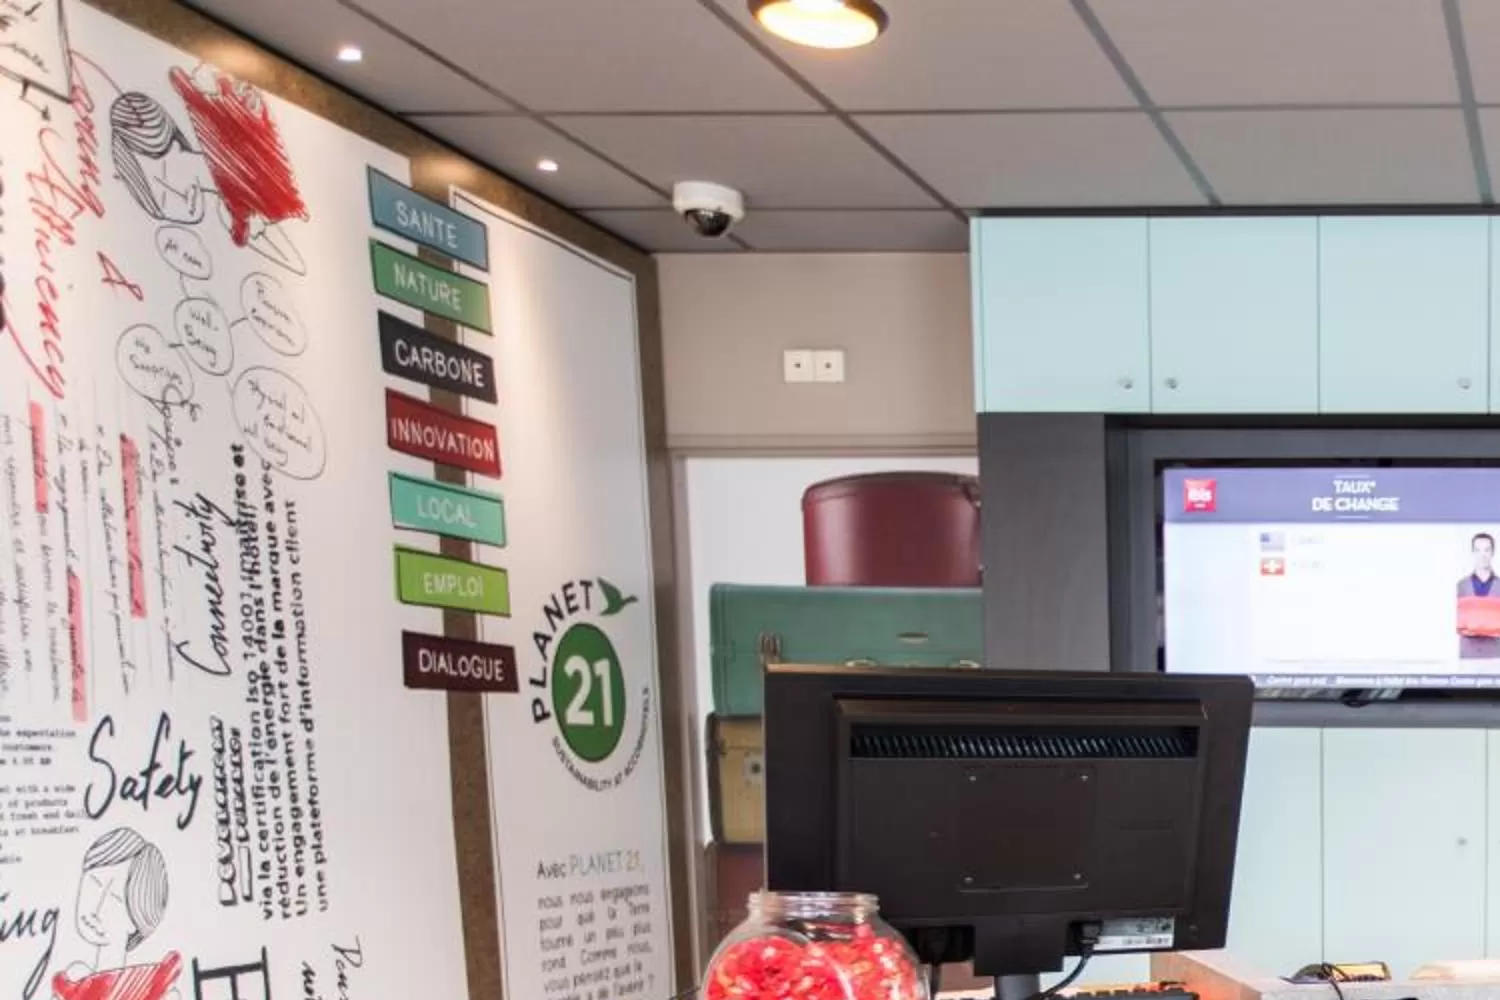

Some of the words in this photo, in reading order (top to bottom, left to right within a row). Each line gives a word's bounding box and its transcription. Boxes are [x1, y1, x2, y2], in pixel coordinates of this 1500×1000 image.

[394, 262, 462, 311] NATURE
[395, 339, 485, 387] CARBONE
[230, 443, 243, 468] et
[391, 417, 496, 463] INNOVATION
[261, 458, 275, 514] avec
[1311, 497, 1333, 511] DE
[1335, 497, 1399, 511] CHANGE
[283, 500, 301, 565] client
[416, 494, 478, 529] LOCAL
[173, 492, 236, 676] Connectivity
[263, 520, 283, 612] marque
[423, 572, 484, 598] EMPLOI
[252, 597, 267, 653] dans
[272, 619, 284, 639] la
[273, 646, 288, 674] de
[288, 572, 314, 732] d'information
[418, 648, 505, 681] DIALOGUE
[529, 580, 593, 724] PLANET
[277, 680, 291, 724] fort
[563, 654, 614, 727] 21
[84, 711, 203, 831] Safety
[251, 711, 270, 853] certification
[267, 770, 281, 799] de
[279, 731, 304, 878] engagement
[304, 738, 327, 865] plateforme
[257, 861, 271, 880] la
[273, 806, 292, 919] réduction
[536, 860, 567, 879] Avec
[569, 851, 623, 877] PLANET
[259, 886, 273, 920] via
[296, 884, 308, 916] Un
[314, 871, 328, 912] une
